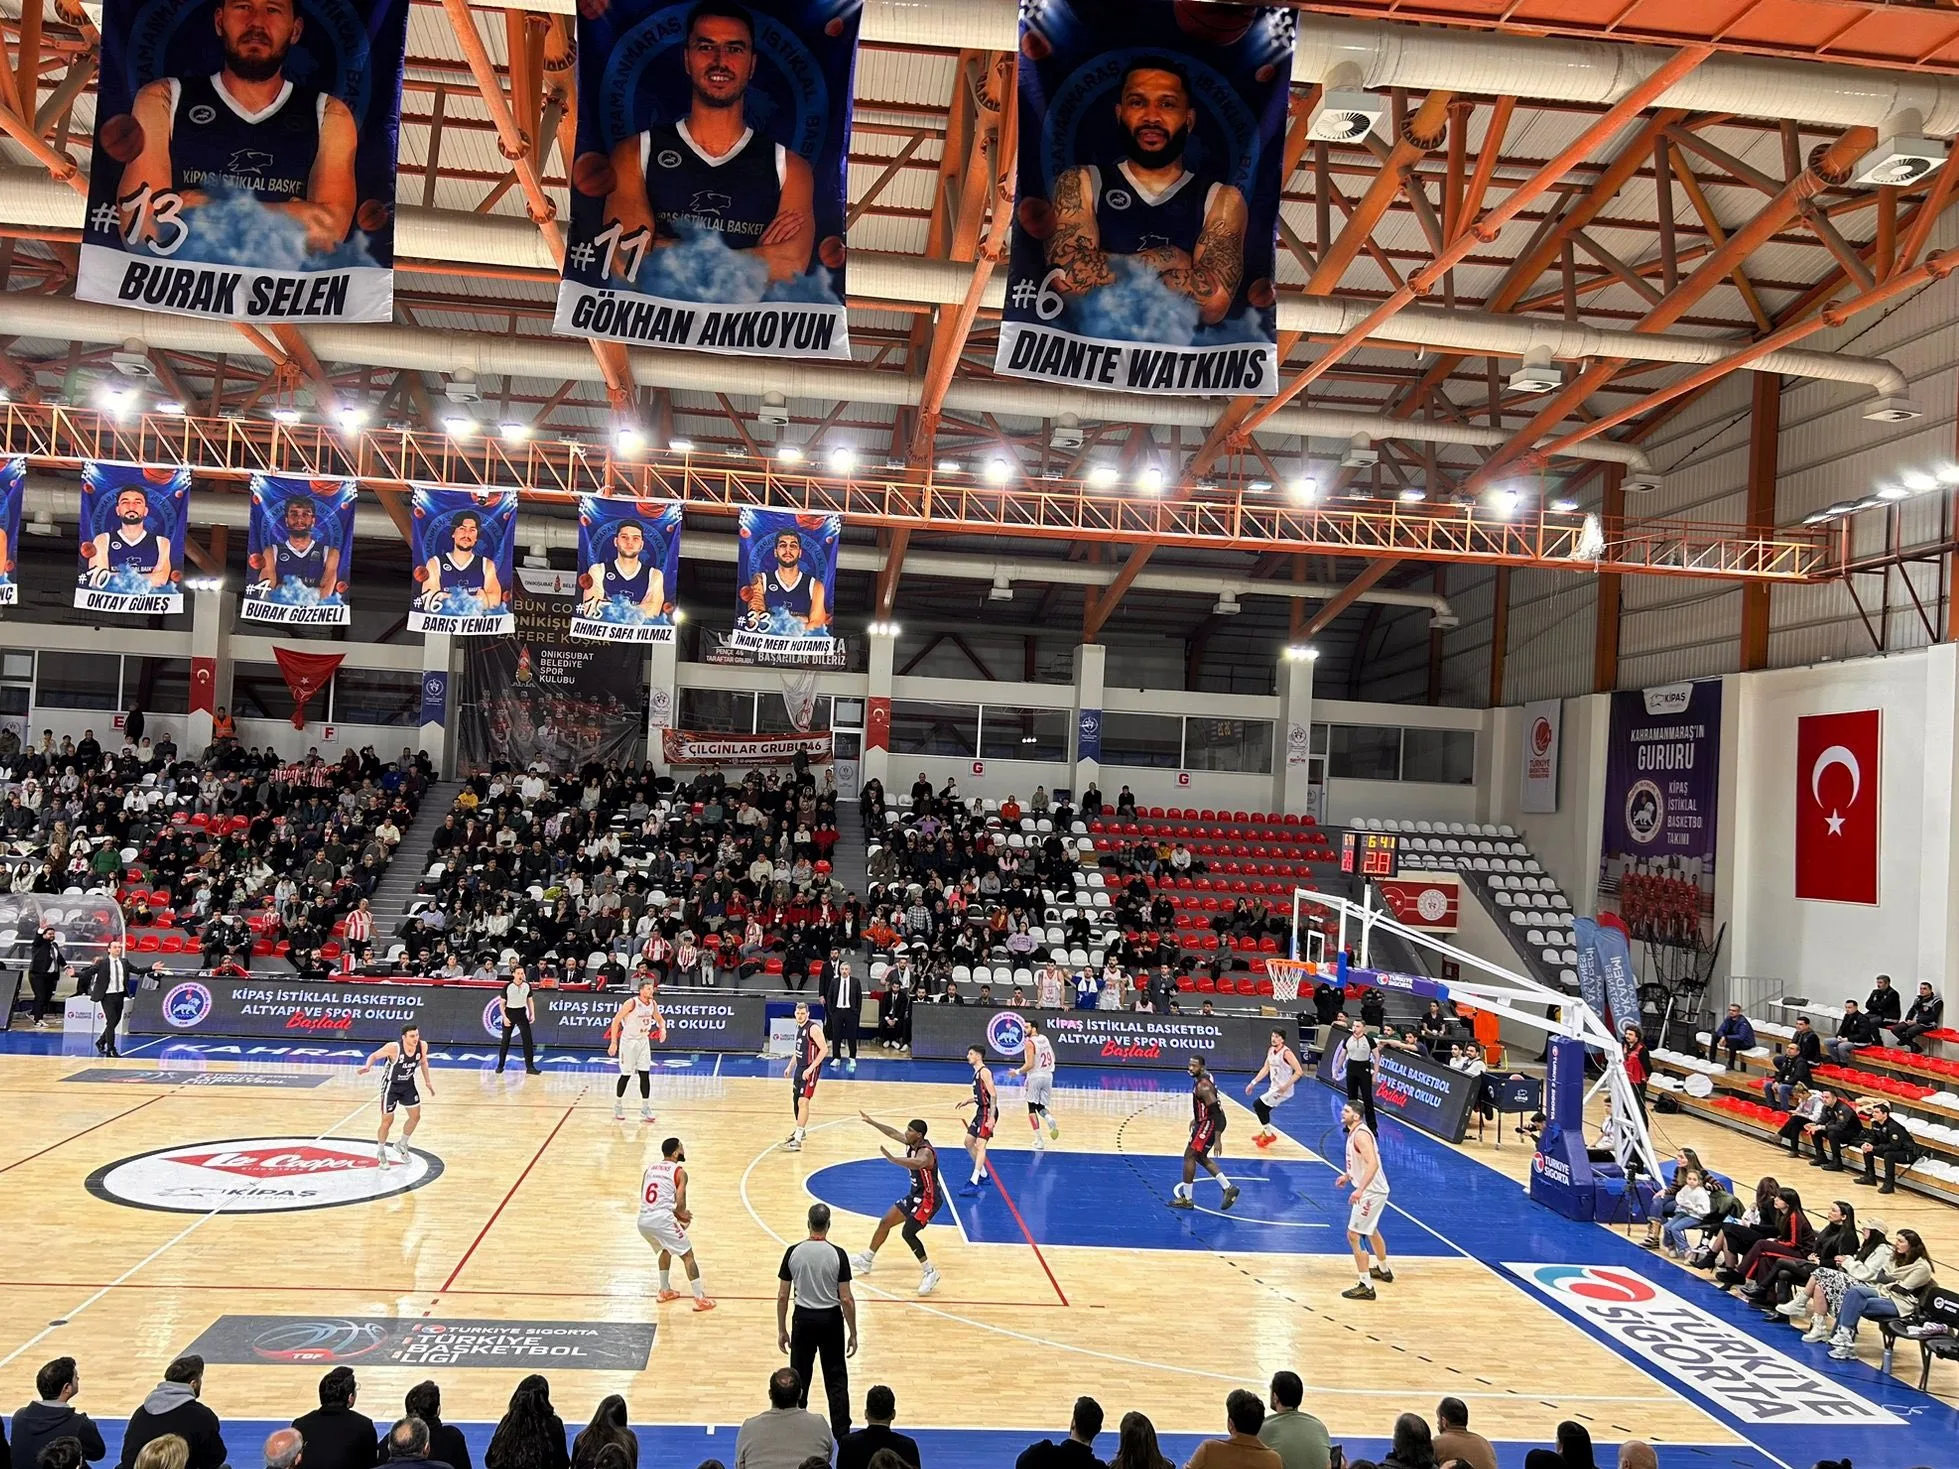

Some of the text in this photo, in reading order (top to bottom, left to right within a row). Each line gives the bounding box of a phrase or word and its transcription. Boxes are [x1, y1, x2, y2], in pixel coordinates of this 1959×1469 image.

[91, 184, 189, 256] #13
[570, 219, 651, 282] #11
[118, 261, 350, 317] BURAK SELEN
[1012, 268, 1066, 320] #6
[571, 290, 836, 350] GÖKHAN AKKOYUN
[1008, 330, 1267, 389] DIANTE WATKINS
[78, 565, 111, 588] #10
[245, 578, 271, 599] #4
[87, 593, 129, 610] OKTAY
[413, 590, 447, 612] #16
[576, 597, 612, 619] #15
[246, 603, 345, 623] BURAK GÖZENELİ
[737, 611, 772, 632] #33
[460, 615, 502, 633] YENİAY
[573, 621, 672, 641] AHMET SAFA YILMAZ
[763, 639, 789, 651] MERT
[540, 658, 582, 668] BELEDİYE
[758, 652, 809, 665] BAŞARILAR
[540, 666, 563, 675] SPOR
[113, 716, 125, 728] E
[325, 727, 334, 739] F
[1631, 724, 1705, 743] KAHRAMANMARAŞ'IN
[1637, 743, 1695, 771] GURURU
[973, 762, 984, 774] G
[1179, 773, 1189, 785] G
[1669, 780, 1688, 796] KİPAŞ
[1668, 797, 1697, 811] İSTİKLAL
[1363, 851, 1391, 875] 28
[232, 988, 425, 1007] KİPAŞ İSTİKLAL BASKETBOL
[304, 1007, 322, 1017] VE
[325, 1008, 361, 1018] SPOR
[365, 1009, 415, 1020] OKULU
[549, 1000, 588, 1015] KİPAŞ
[658, 1004, 735, 1016] BASKETBOL
[679, 1019, 726, 1030] OKULU
[1047, 1017, 1222, 1036] KİPAŞ İSTİKLAL BASKETBOL
[1116, 1036, 1130, 1046] VE
[1134, 1037, 1167, 1048] SPOR
[1170, 1038, 1215, 1049] OKULU
[1041, 1052, 1053, 1068] 29
[1407, 1069, 1450, 1094] BASKETBOL
[1415, 1089, 1442, 1108] OKULU
[259, 1154, 368, 1171] Cooper
[645, 1183, 658, 1204] 6
[417, 1333, 543, 1346] TÜRKİYE
[406, 1344, 588, 1356] BASKETBOL
[1586, 1305, 1800, 1418] SİGORTA
[1647, 1308, 1875, 1416] TÜRKİYE
